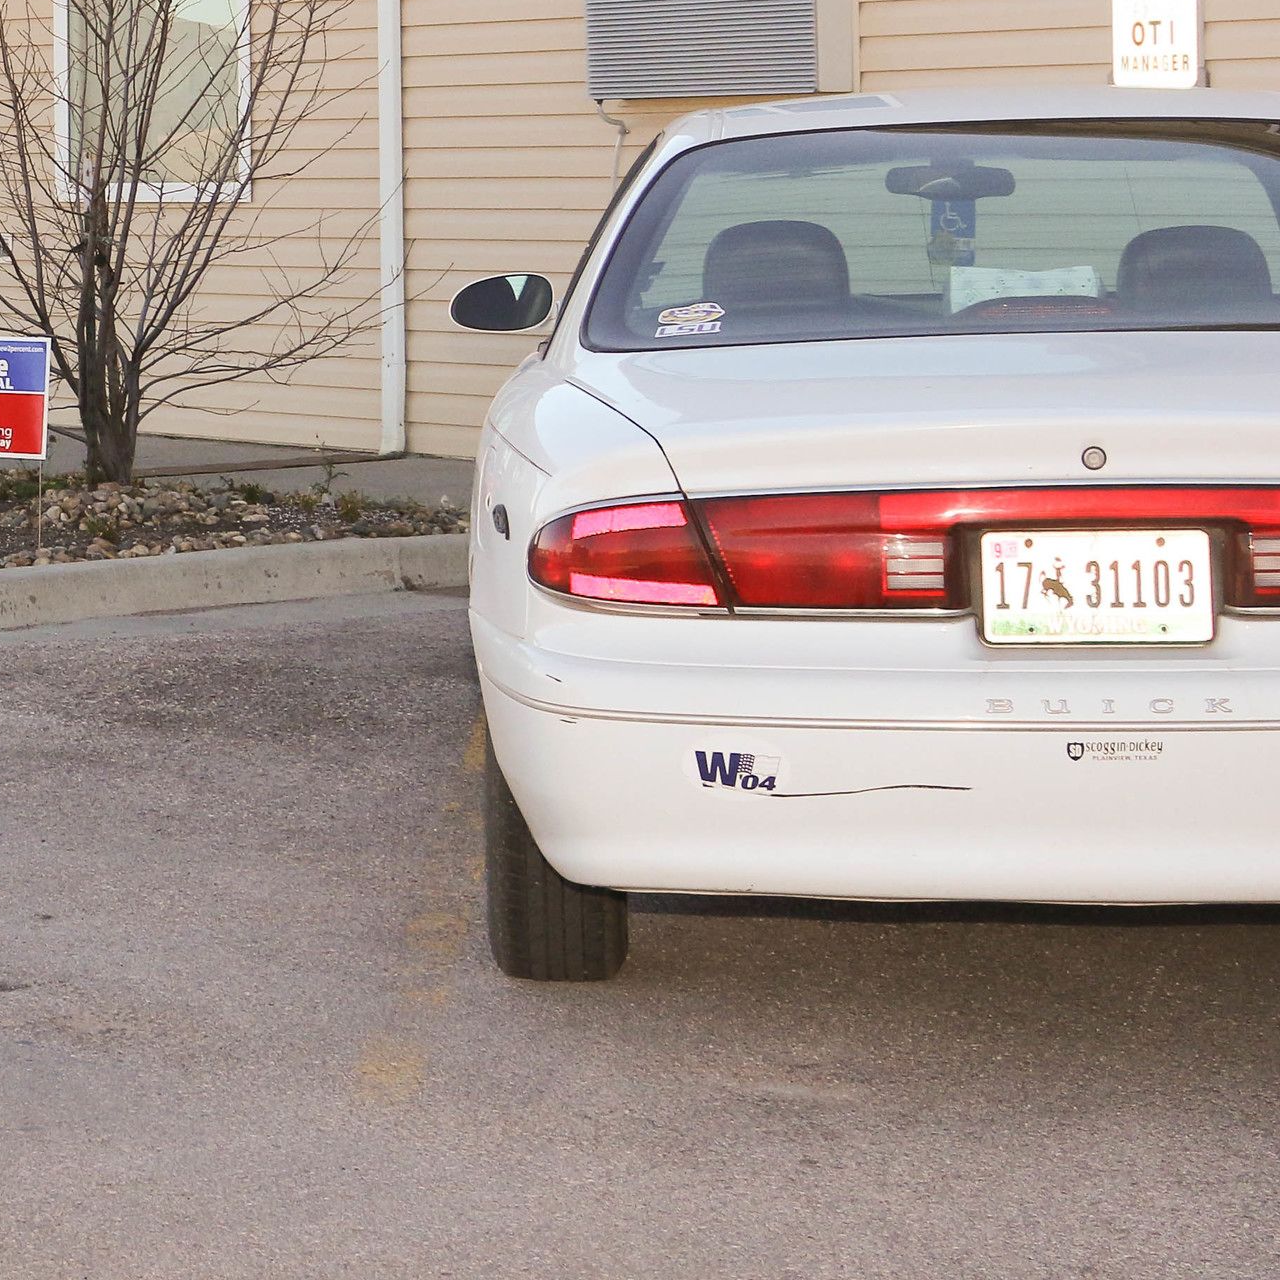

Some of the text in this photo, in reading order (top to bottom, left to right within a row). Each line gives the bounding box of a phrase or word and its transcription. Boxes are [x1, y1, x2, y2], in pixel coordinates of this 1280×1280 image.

[1121, 54, 1189, 72] MANAGER
[658, 323, 717, 336] LSU
[995, 560, 1195, 609] 17 31103
[1044, 613, 1148, 635] WYOMING
[986, 698, 1232, 714] BUICK
